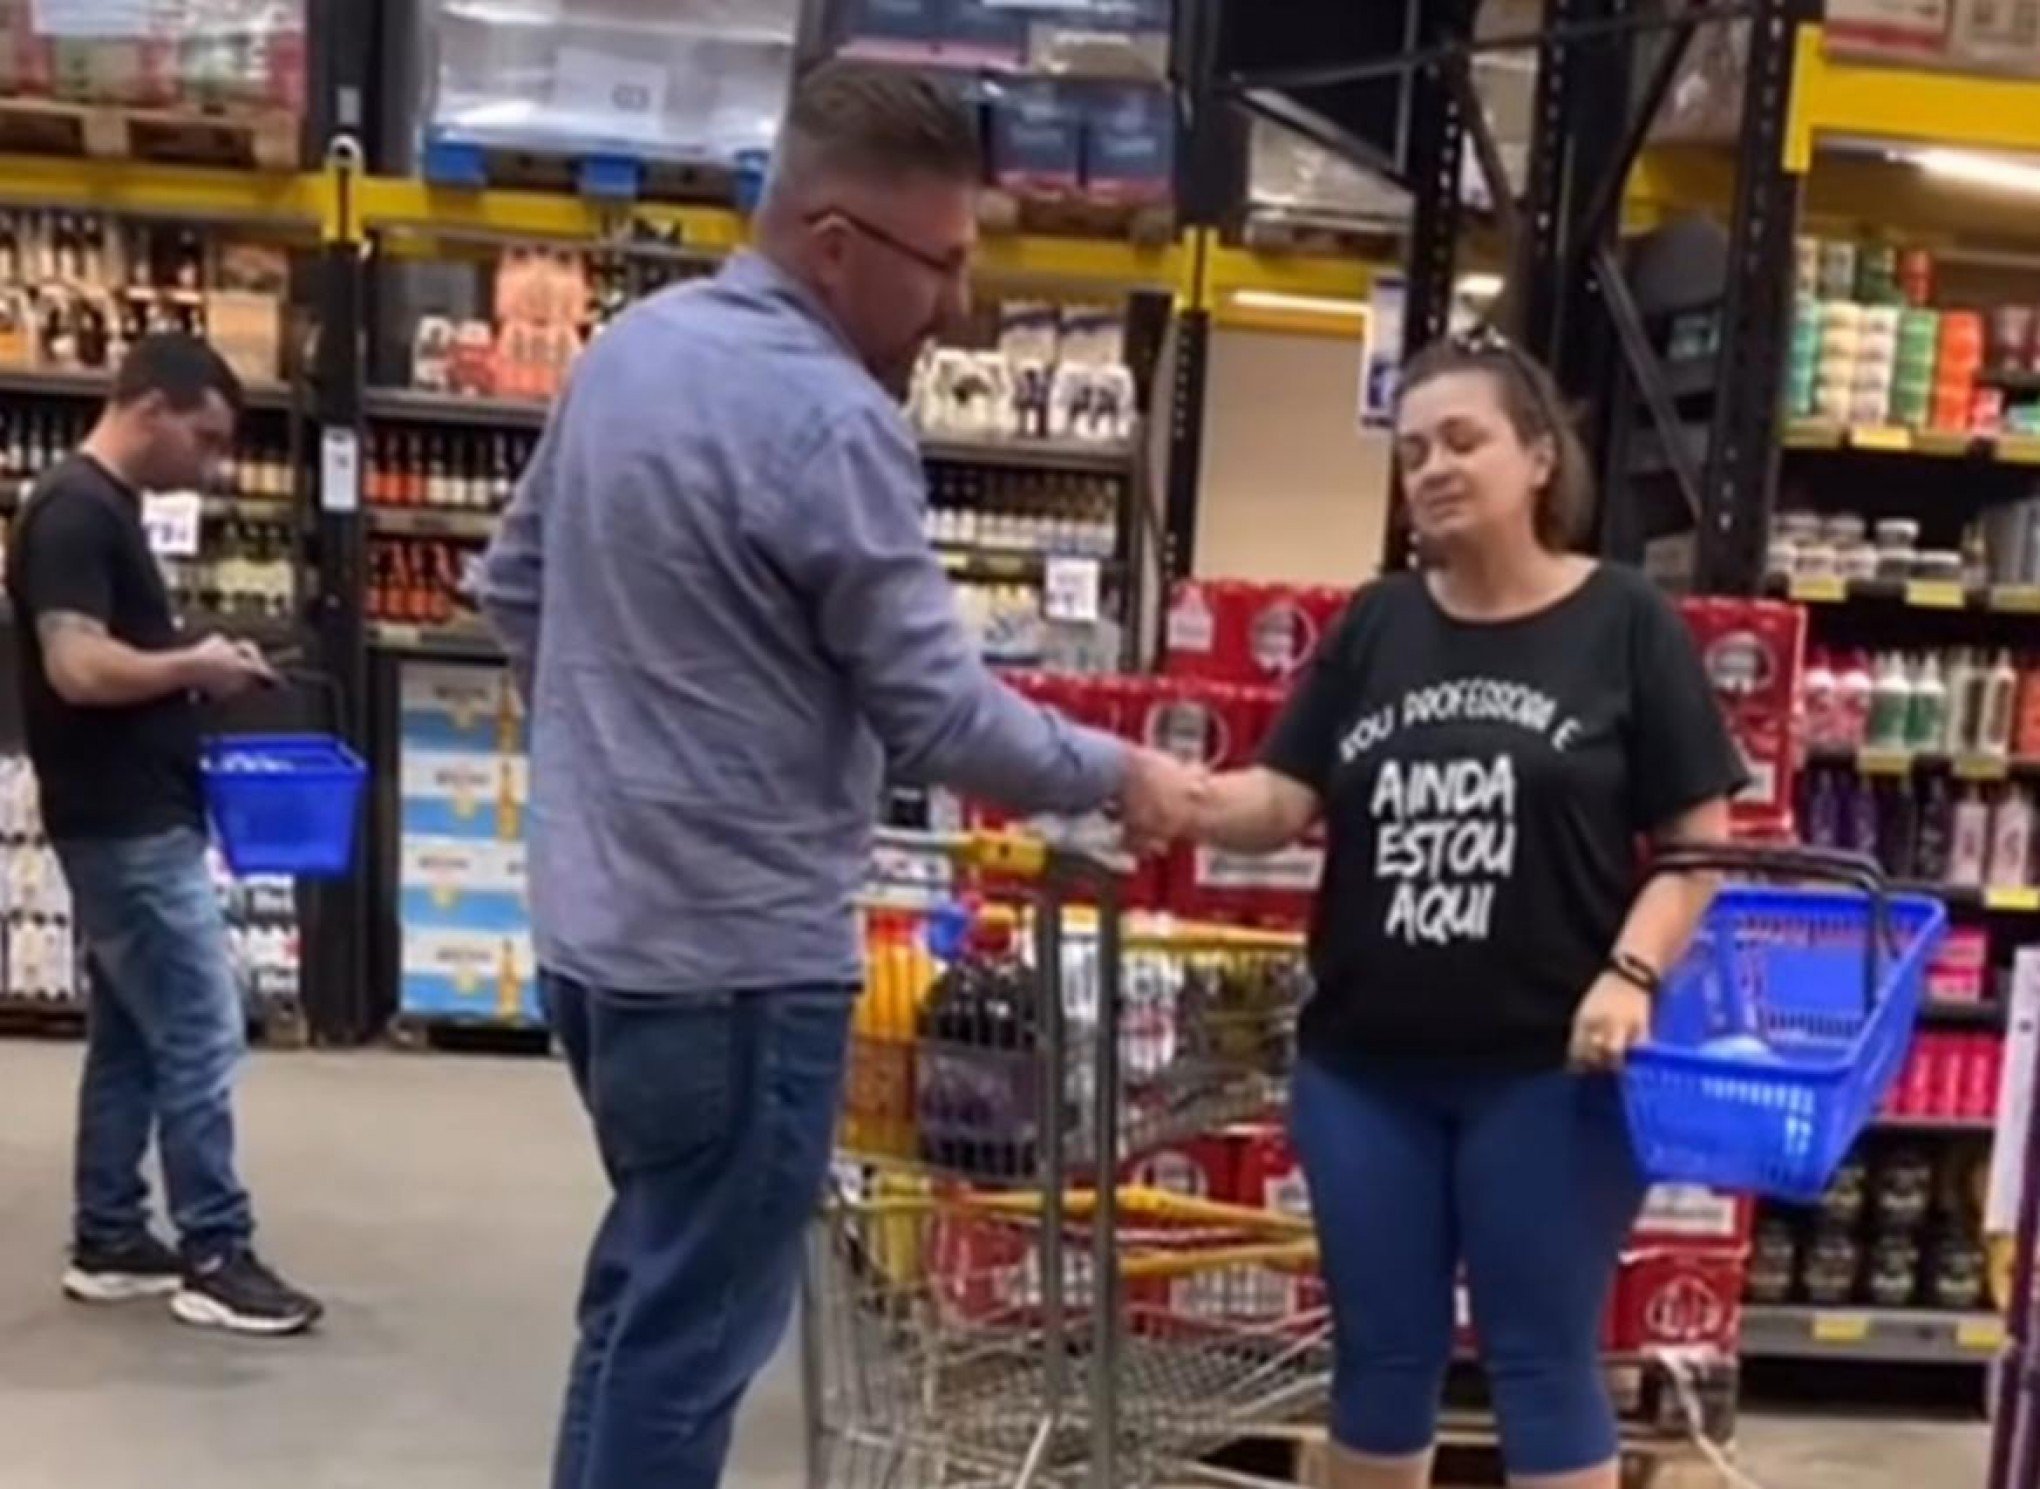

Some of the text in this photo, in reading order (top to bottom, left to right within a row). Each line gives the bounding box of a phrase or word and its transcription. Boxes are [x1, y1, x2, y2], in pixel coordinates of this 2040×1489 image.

[1370, 754, 1516, 822] AINDA
[1375, 820, 1516, 880] ESTOU
[1385, 881, 1496, 945] AQUI
